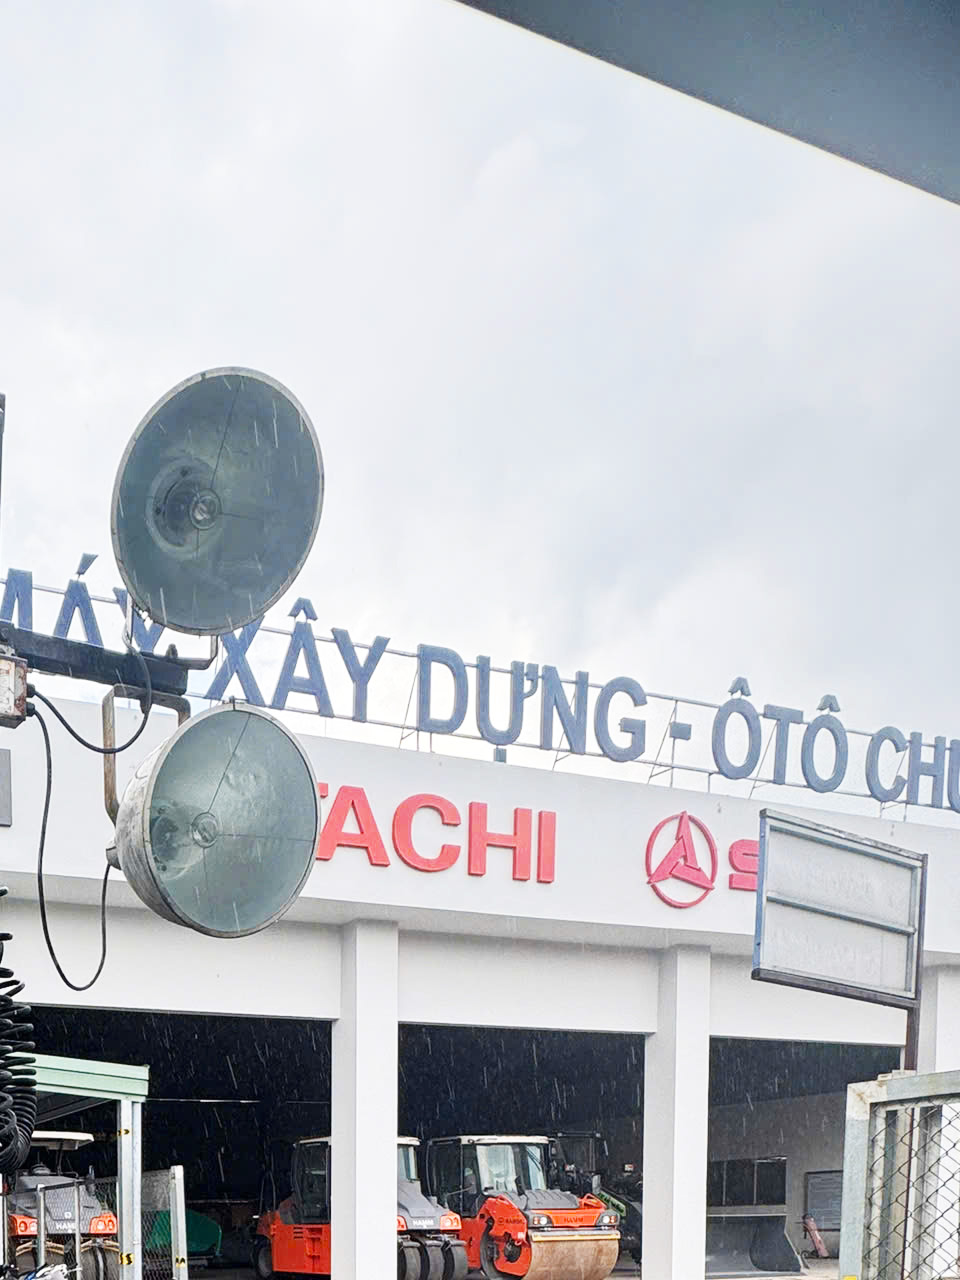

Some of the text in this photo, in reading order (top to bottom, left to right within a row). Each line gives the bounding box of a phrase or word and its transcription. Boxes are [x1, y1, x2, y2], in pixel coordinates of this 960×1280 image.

[204, 597, 391, 722] XÂY
[417, 644, 647, 763] DỰNG
[865, 726, 960, 814] CH
